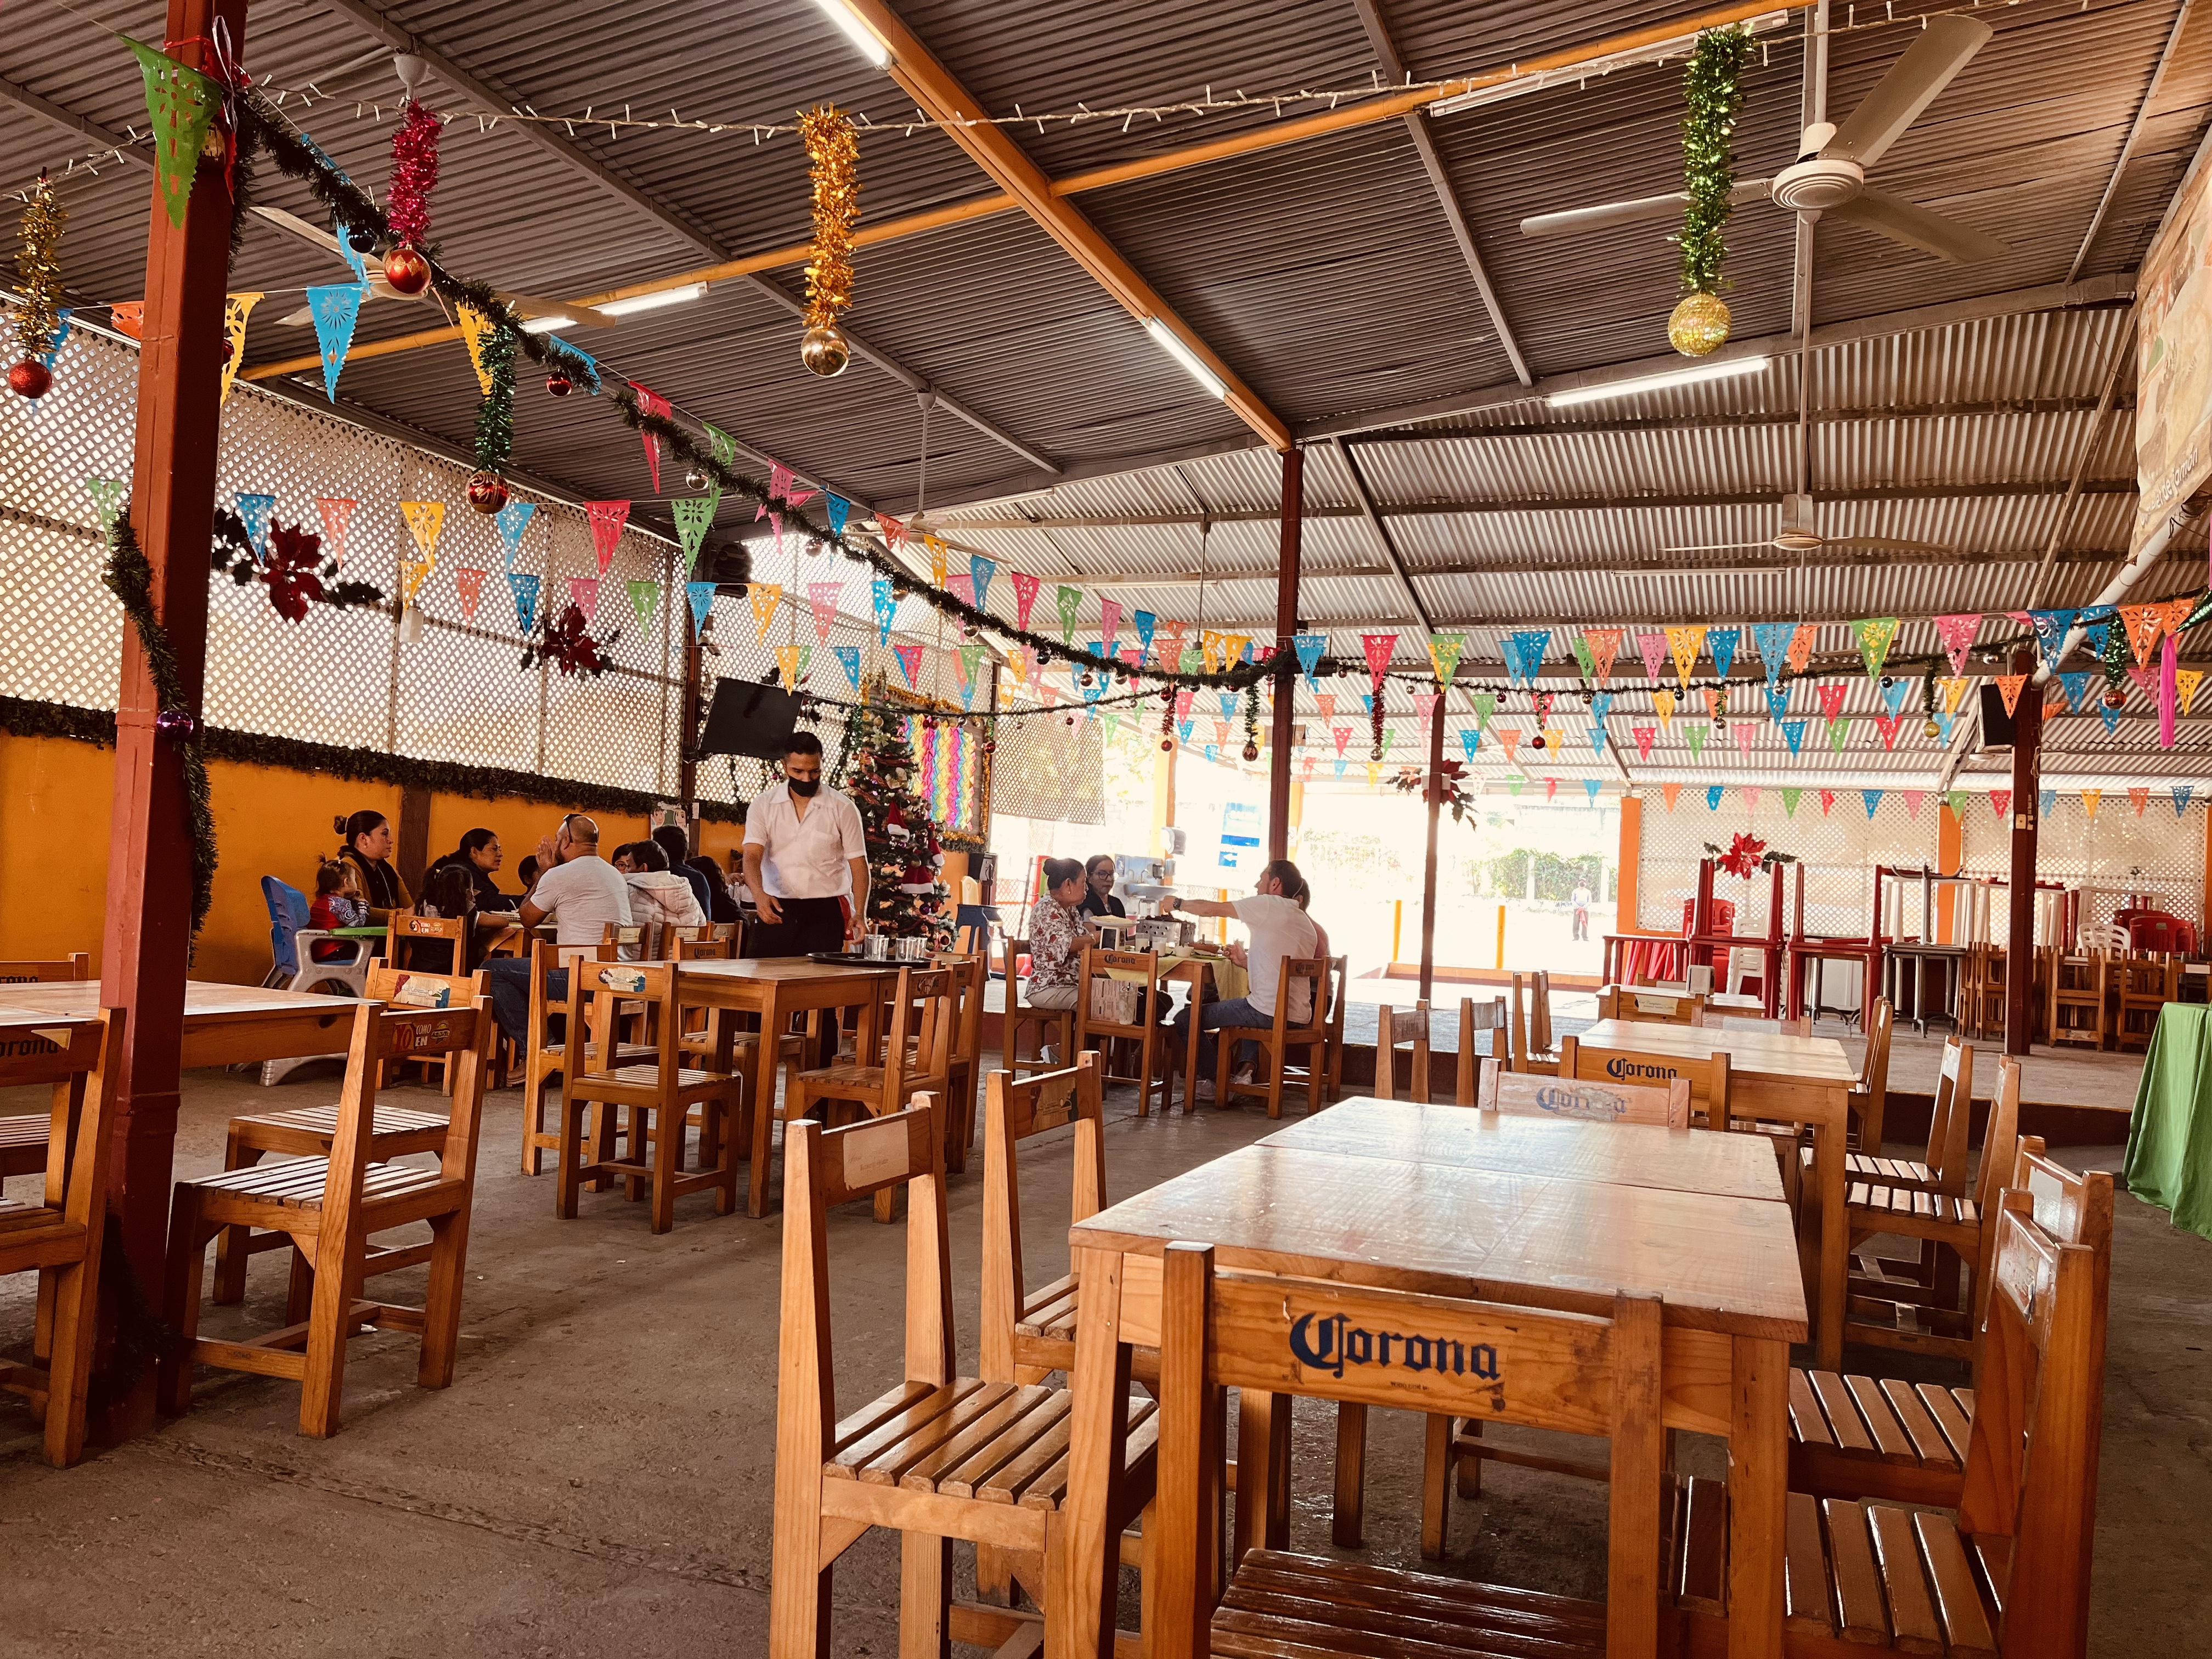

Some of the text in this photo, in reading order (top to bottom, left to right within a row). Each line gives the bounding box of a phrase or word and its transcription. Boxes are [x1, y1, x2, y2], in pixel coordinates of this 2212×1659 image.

[1104, 953, 1136, 965] Corona
[416, 1024, 432, 1035] COMO
[415, 1036, 428, 1047] EN
[1606, 1058, 1678, 1081] Corona
[1289, 1312, 1501, 1381] Corona
